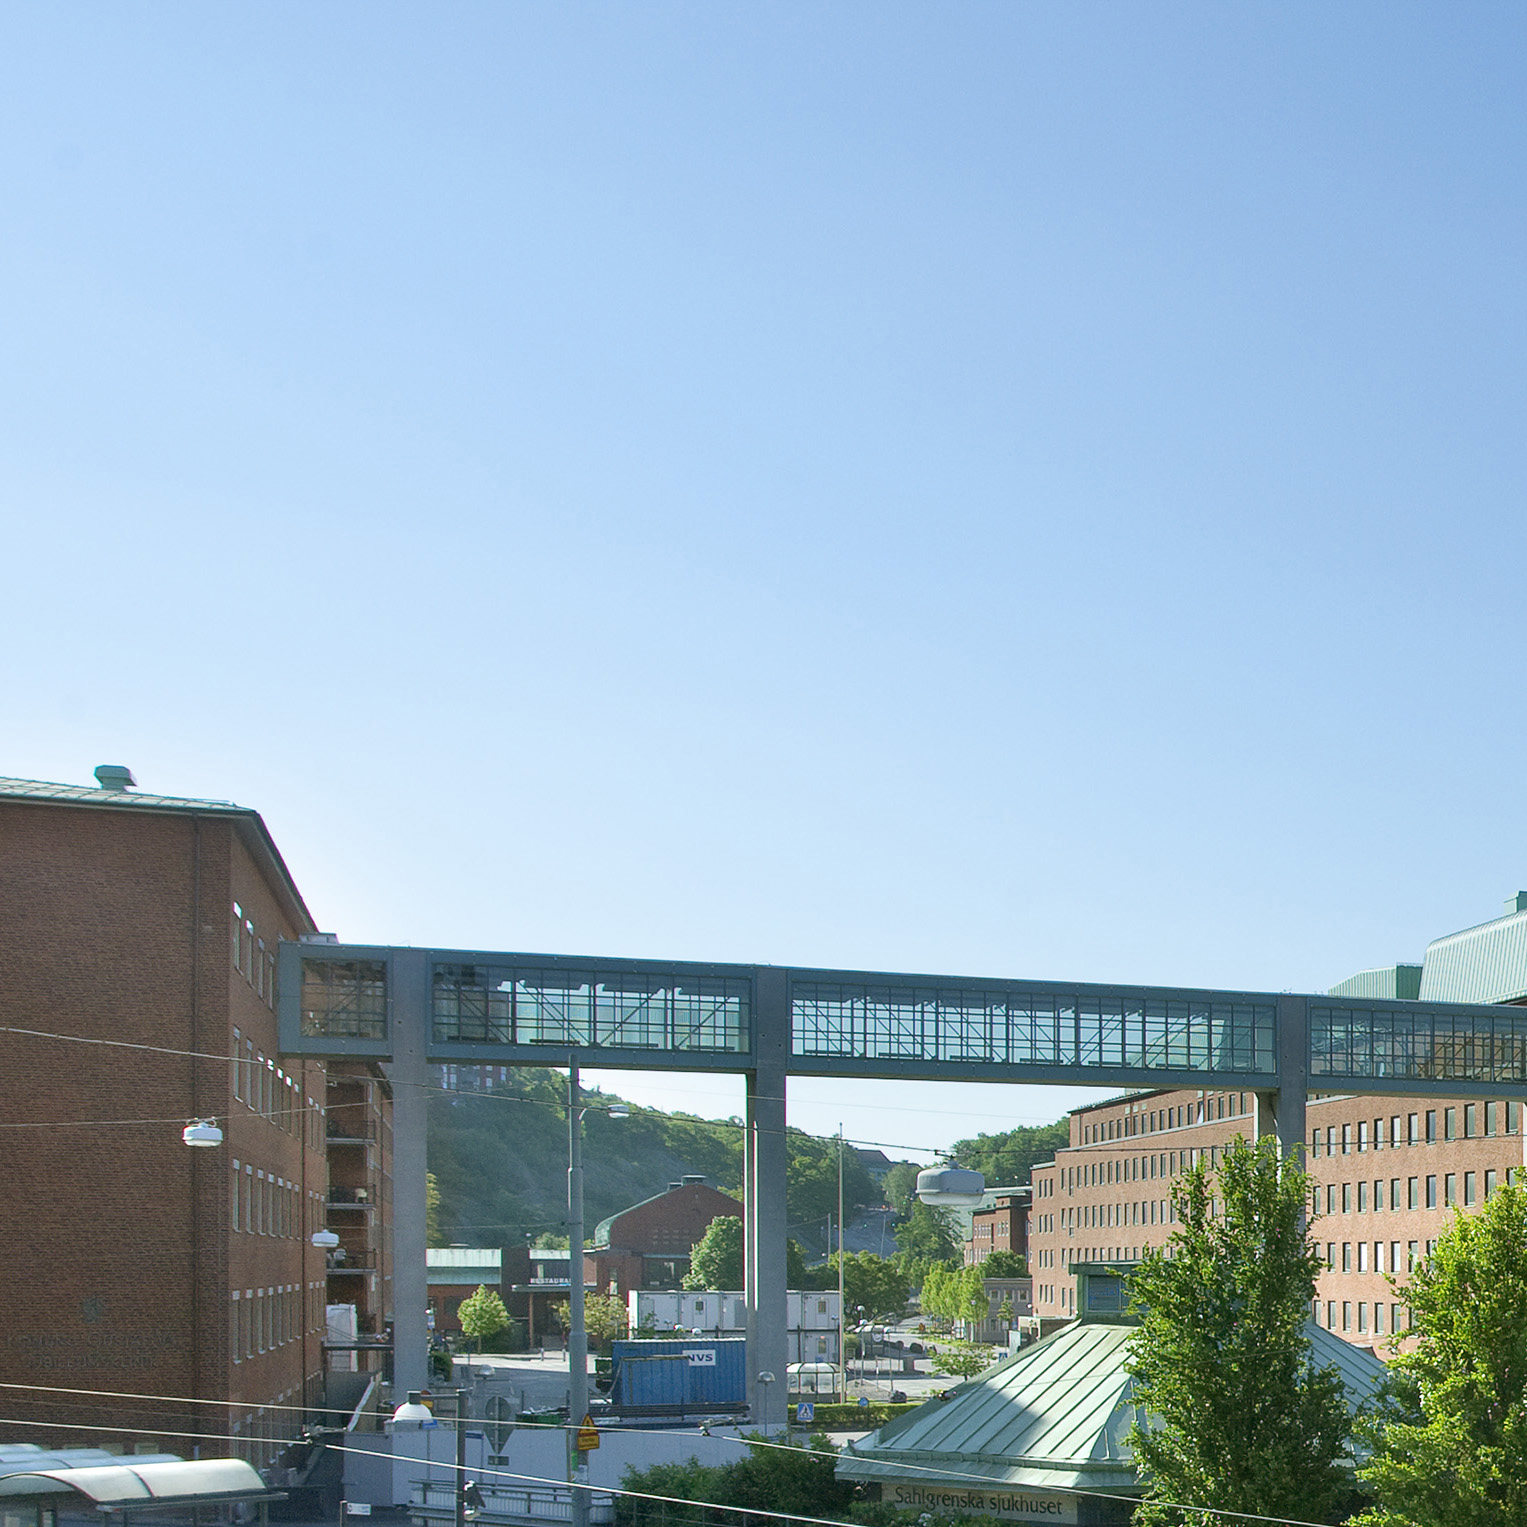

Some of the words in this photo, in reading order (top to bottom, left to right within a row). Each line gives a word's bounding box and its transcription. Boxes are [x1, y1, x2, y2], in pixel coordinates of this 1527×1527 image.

[688, 1353, 713, 1362] NVS
[895, 1487, 985, 1512] Sahlgrenska
[989, 1494, 1063, 1515] sjukhuset
